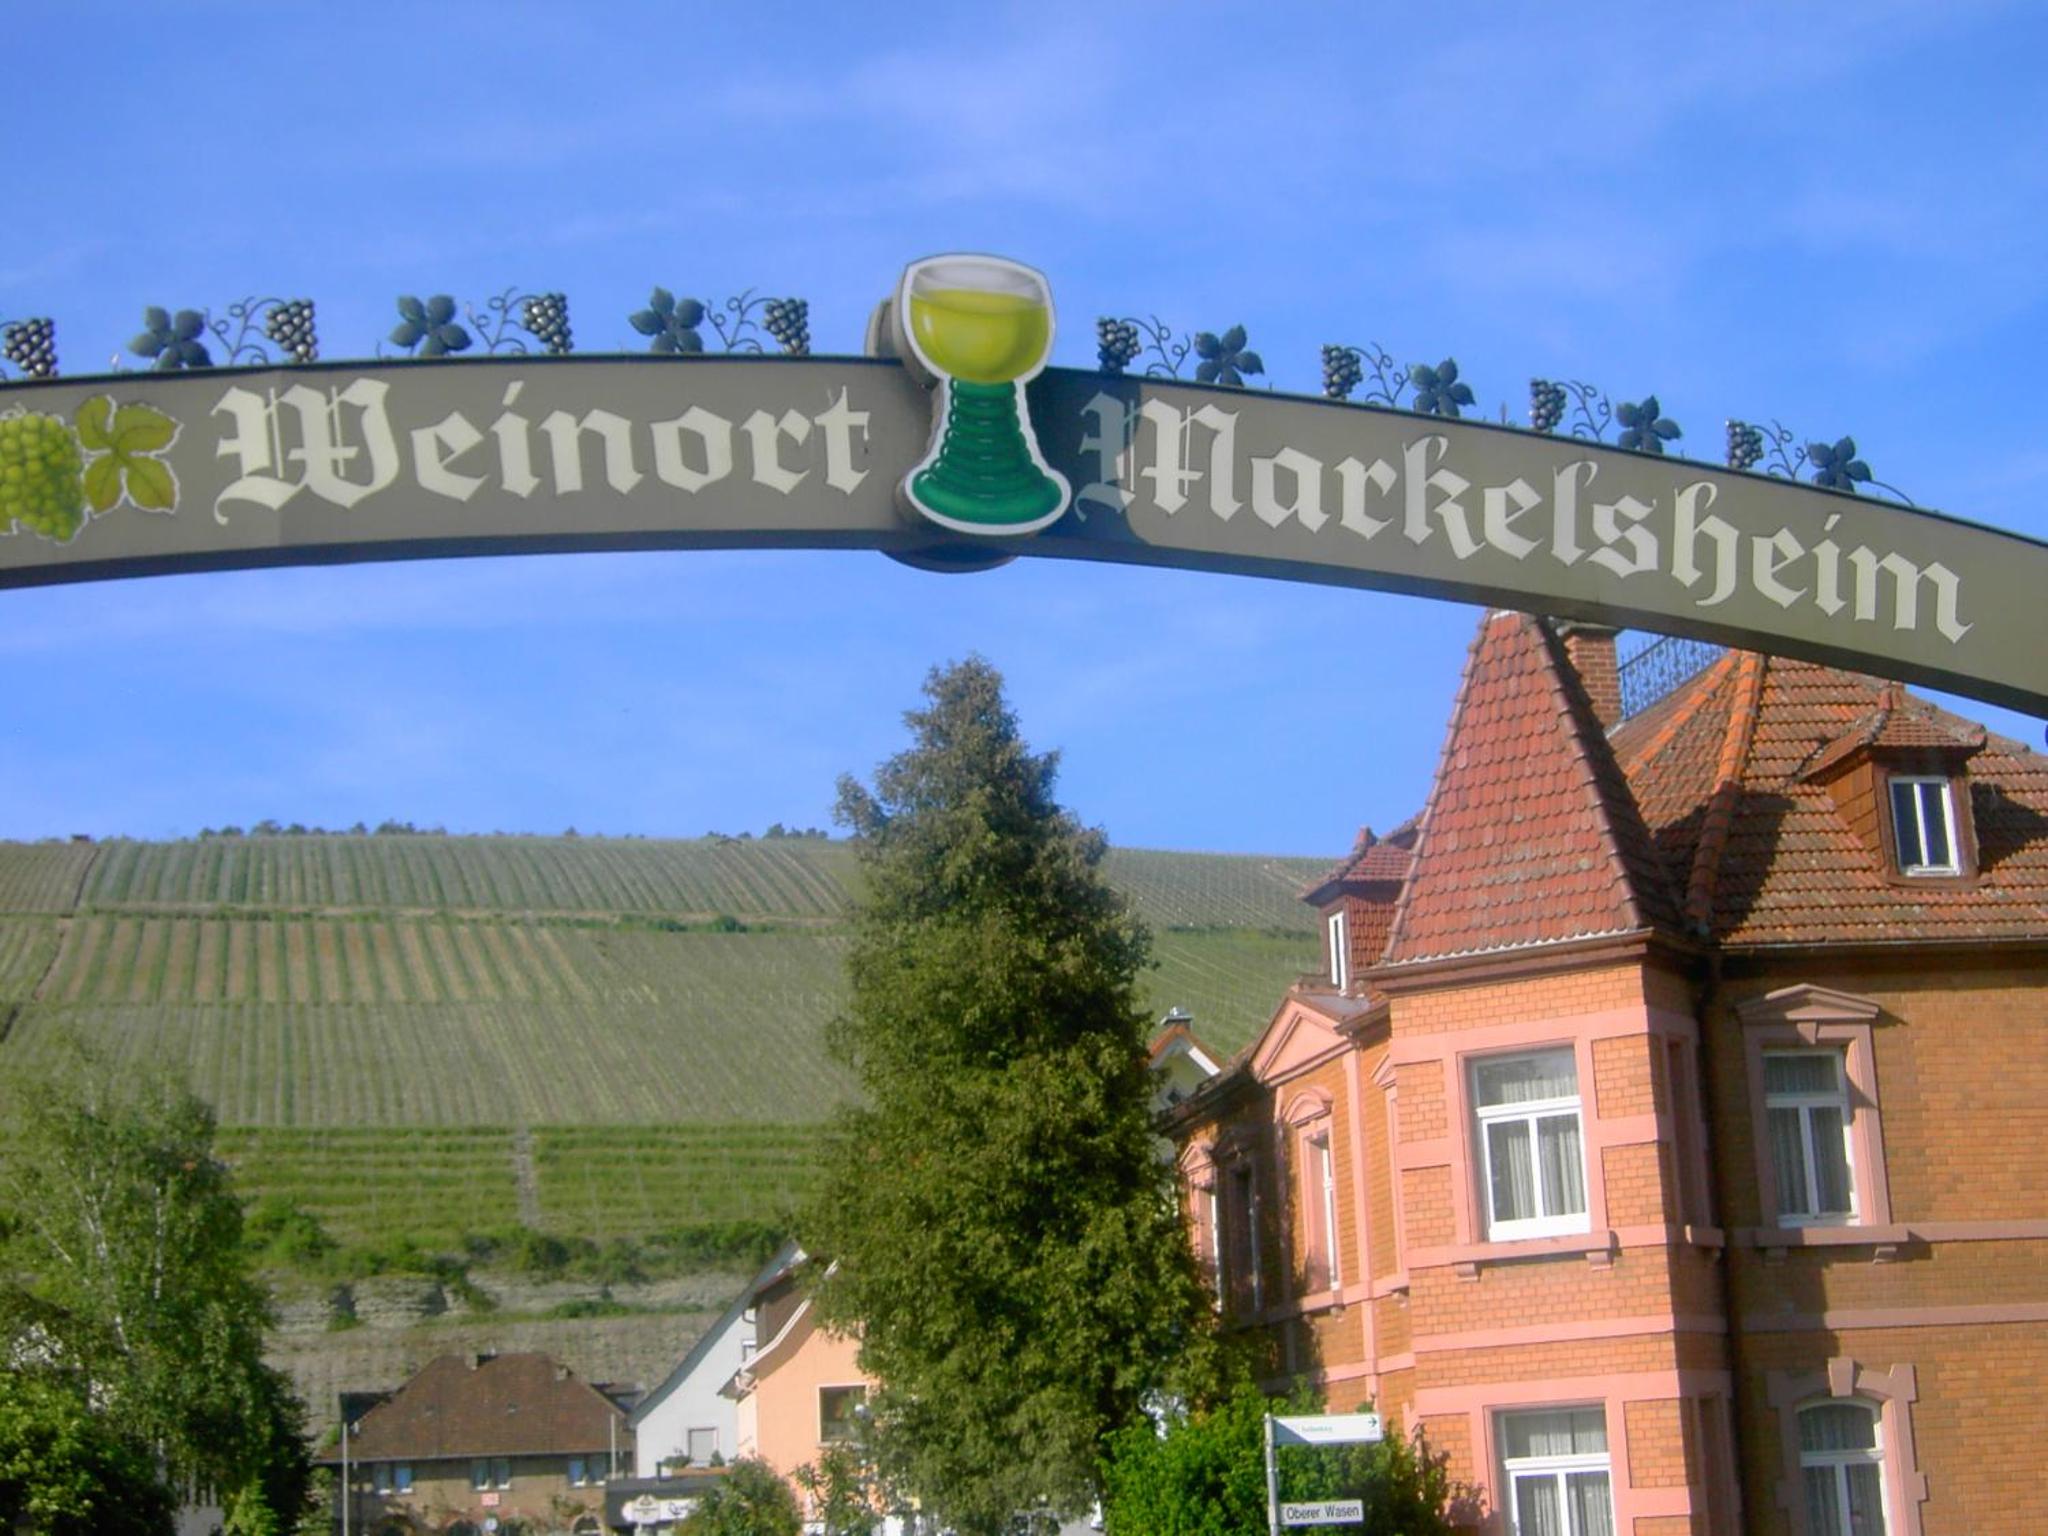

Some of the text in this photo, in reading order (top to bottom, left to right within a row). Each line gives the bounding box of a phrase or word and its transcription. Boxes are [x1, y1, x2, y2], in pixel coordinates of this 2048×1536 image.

[210, 377, 1974, 643] Weinort Markelsheim
[1286, 1504, 1360, 1520] Oberer Wasen
